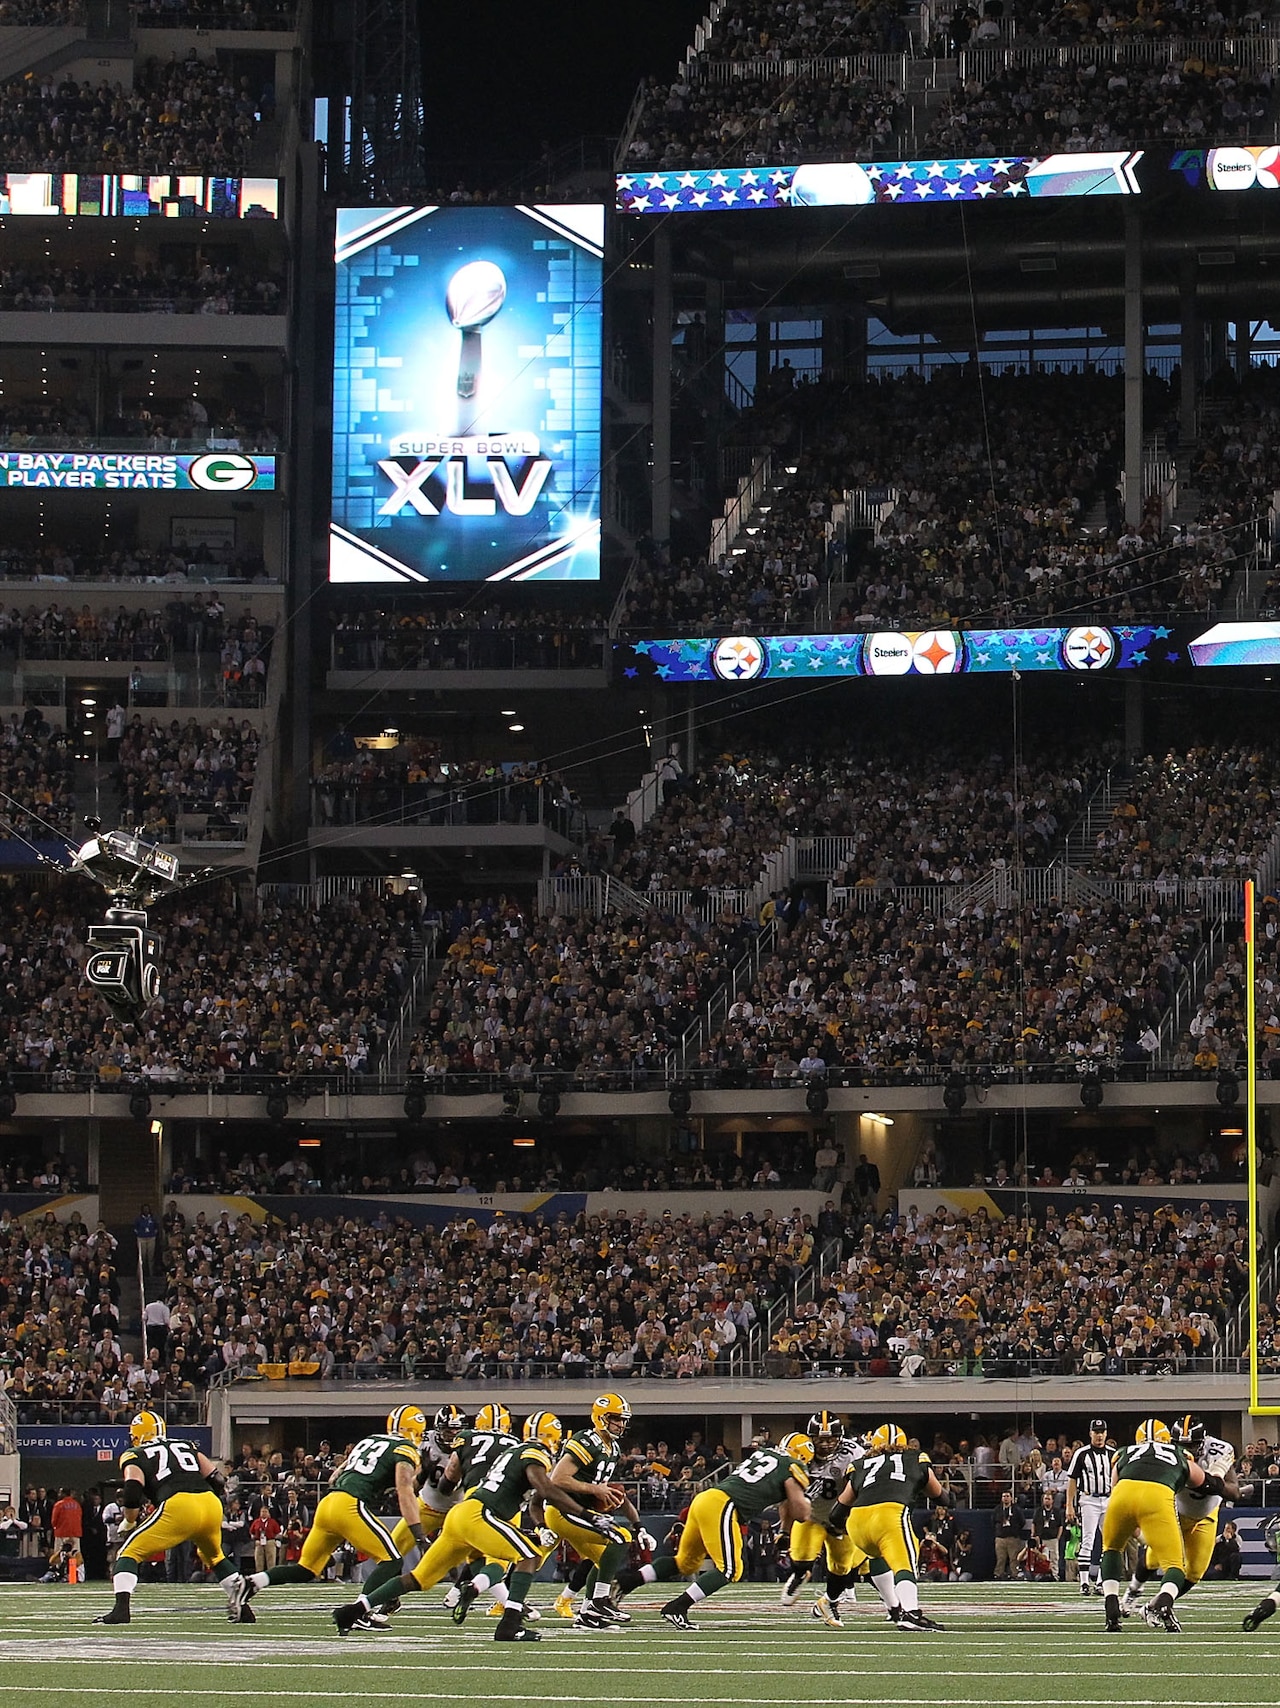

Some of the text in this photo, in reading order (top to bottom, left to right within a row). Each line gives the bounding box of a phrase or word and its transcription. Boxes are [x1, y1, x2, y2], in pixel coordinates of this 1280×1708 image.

[1217, 161, 1252, 172] Steelers
[399, 442, 531, 454] SUPER BOWL
[18, 454, 65, 471] BAY
[73, 455, 177, 472] PACKERS
[8, 471, 177, 489] PLAYER STATS
[377, 460, 553, 517] XLV
[874, 647, 909, 659] Steelers
[155, 856, 172, 873] FOX
[96, 965, 112, 974] FOX
[479, 1196, 493, 1205] 121
[16, 1438, 52, 1448] SUPER
[57, 1439, 88, 1447] BOWL
[92, 1437, 120, 1448] XLV
[1208, 1441, 1226, 1456] 93
[143, 1442, 201, 1482] 76
[344, 1438, 391, 1475] 83
[1126, 1442, 1178, 1466] 75
[862, 1453, 907, 1489] 71
